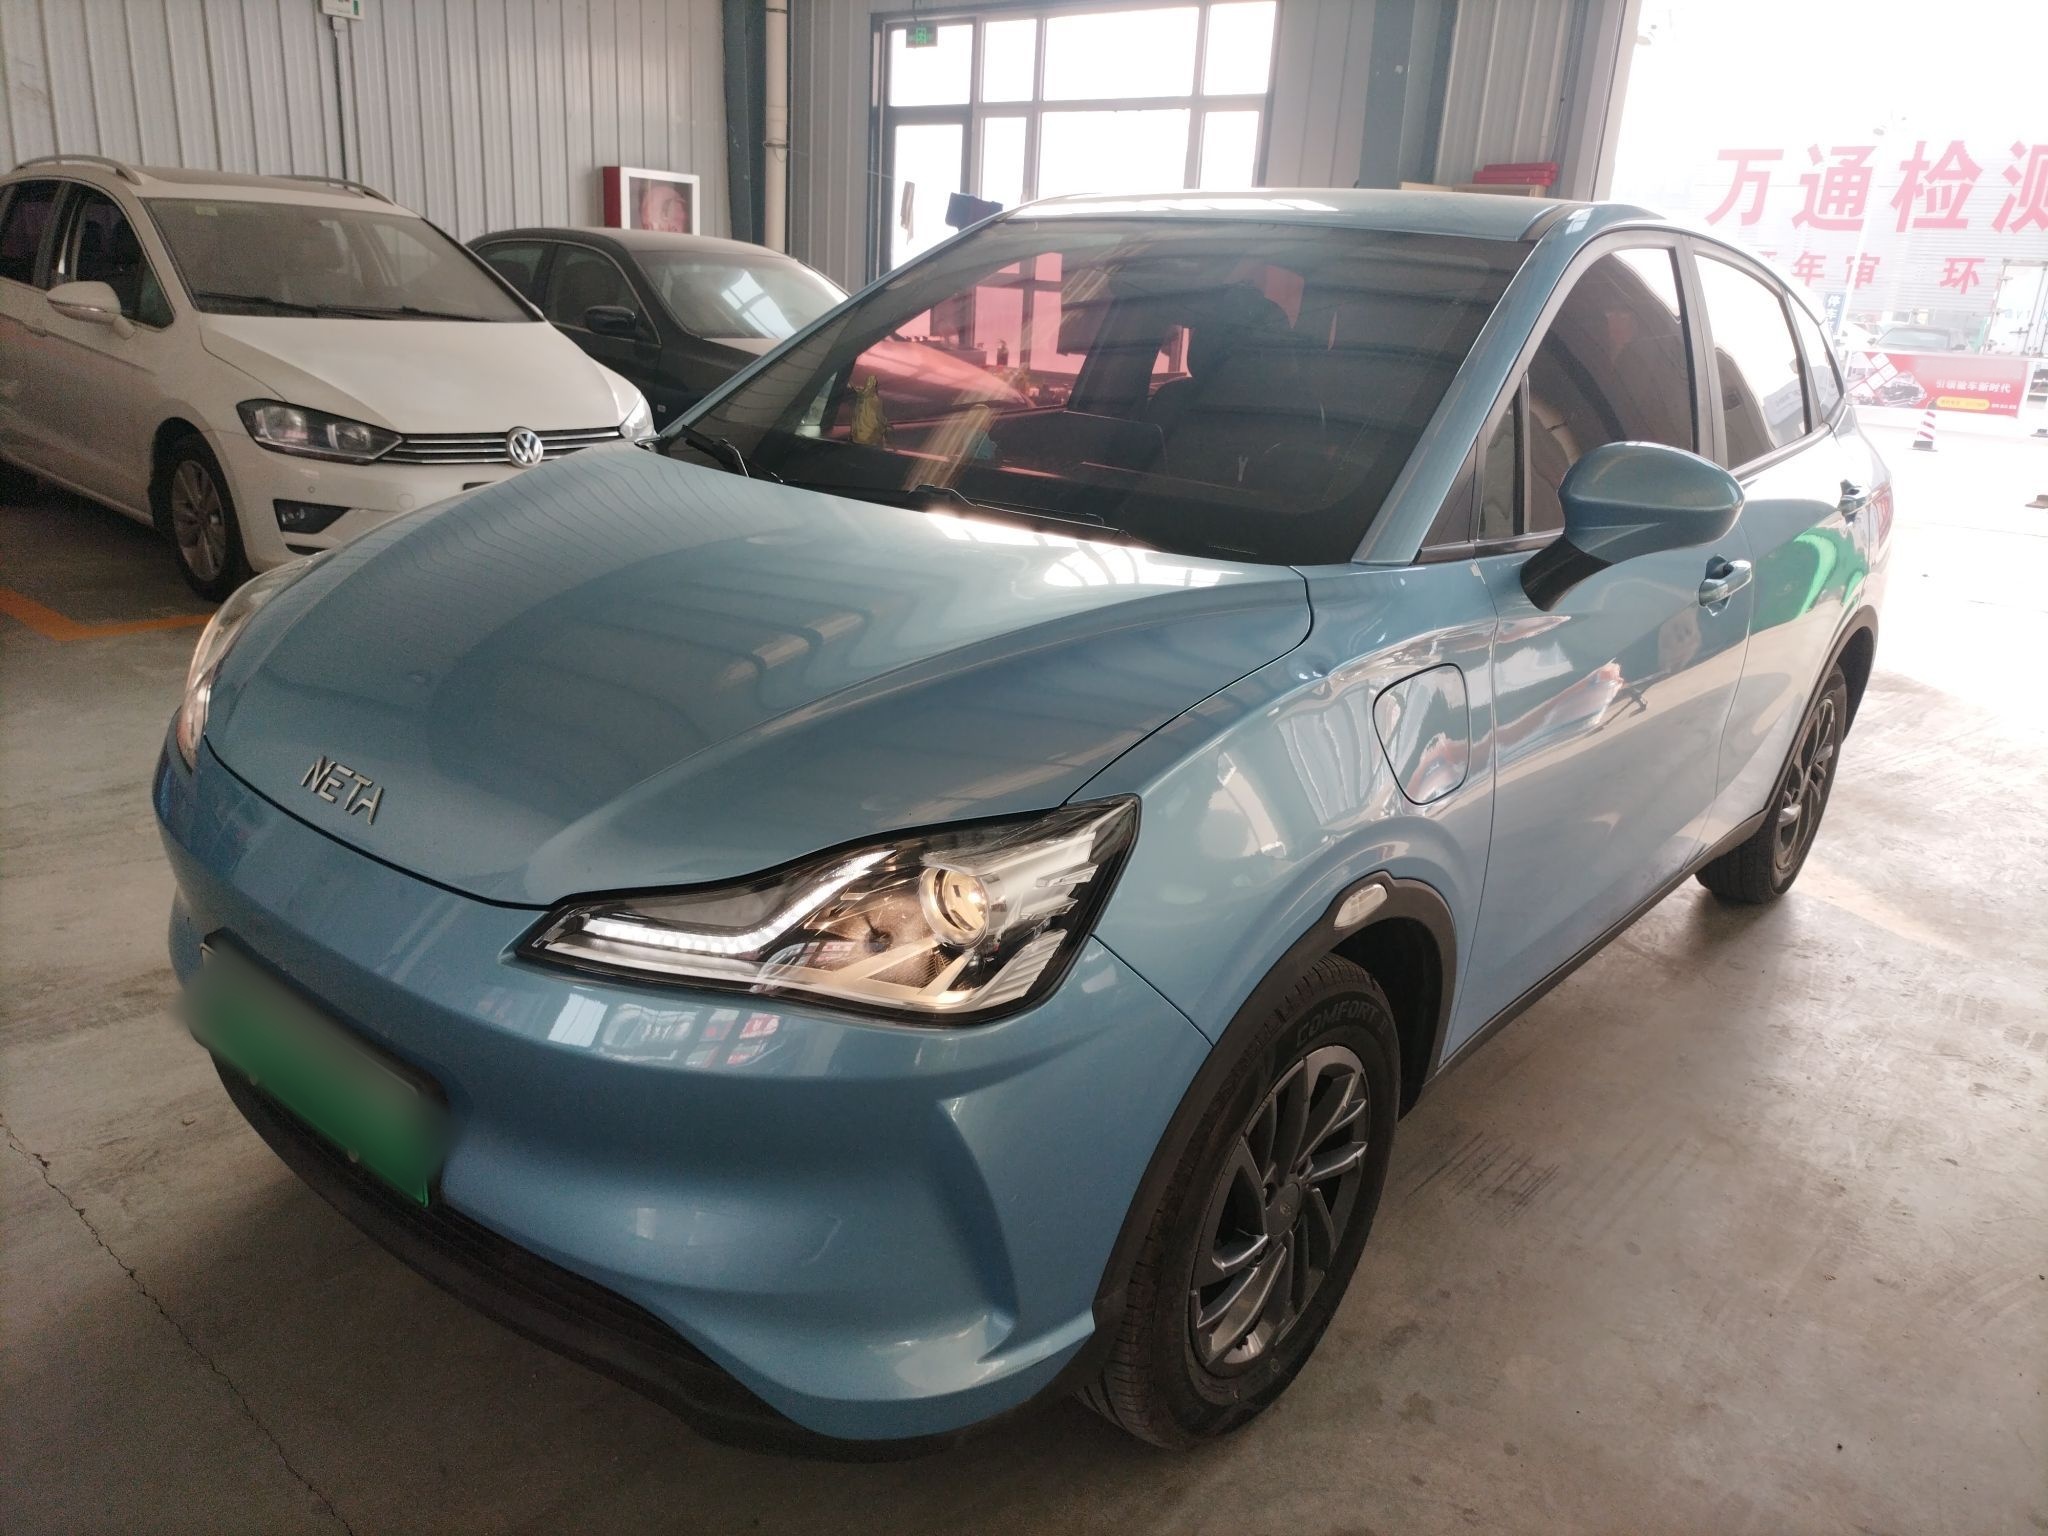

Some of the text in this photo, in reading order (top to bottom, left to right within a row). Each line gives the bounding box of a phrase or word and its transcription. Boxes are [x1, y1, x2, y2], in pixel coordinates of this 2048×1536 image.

[1704, 140, 2048, 233] 万通检测
[1759, 250, 1880, 289] 年审
[1936, 378, 2012, 394] 引领验车新时代
[301, 755, 385, 826] NETA
[1296, 1000, 1378, 1047] COMFORT
